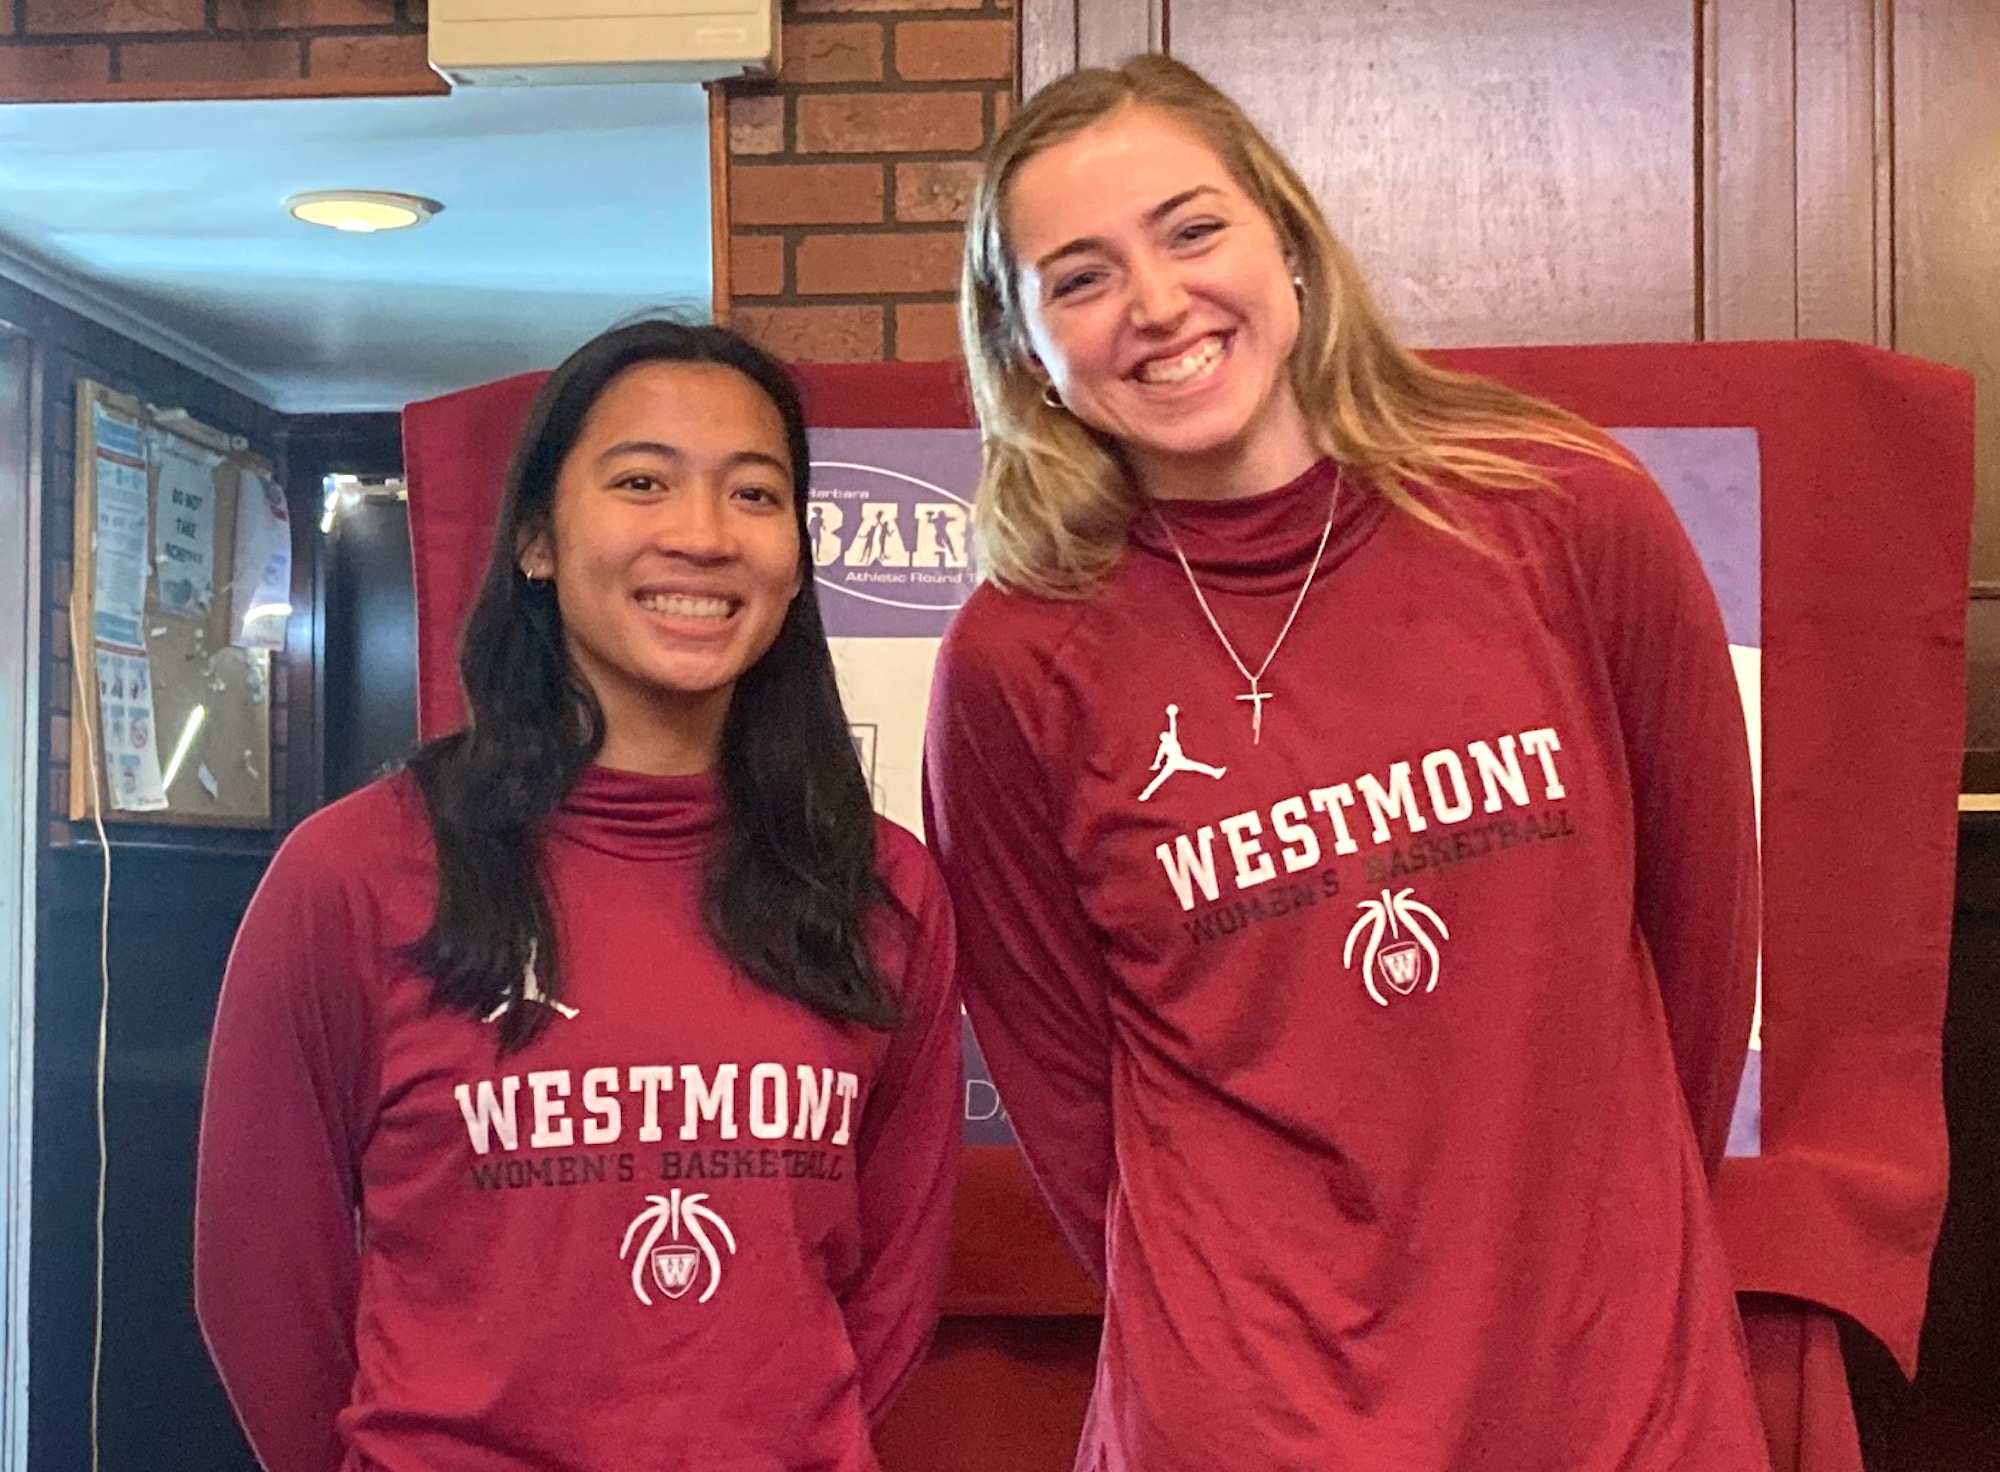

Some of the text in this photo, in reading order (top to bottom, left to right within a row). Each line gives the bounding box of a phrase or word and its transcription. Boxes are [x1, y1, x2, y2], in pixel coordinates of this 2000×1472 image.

[807, 502, 977, 568] BAR
[845, 571, 907, 584] Athletic
[910, 572, 963, 584] Round
[1155, 727, 1566, 912] WESTMONT
[1183, 808, 1576, 946] WOMEN'S BASKETBALL
[1383, 950, 1417, 984] W
[454, 1062, 859, 1155] WESTMONT
[470, 1152, 635, 1191] WOMEN'S
[656, 1253, 694, 1287] W
